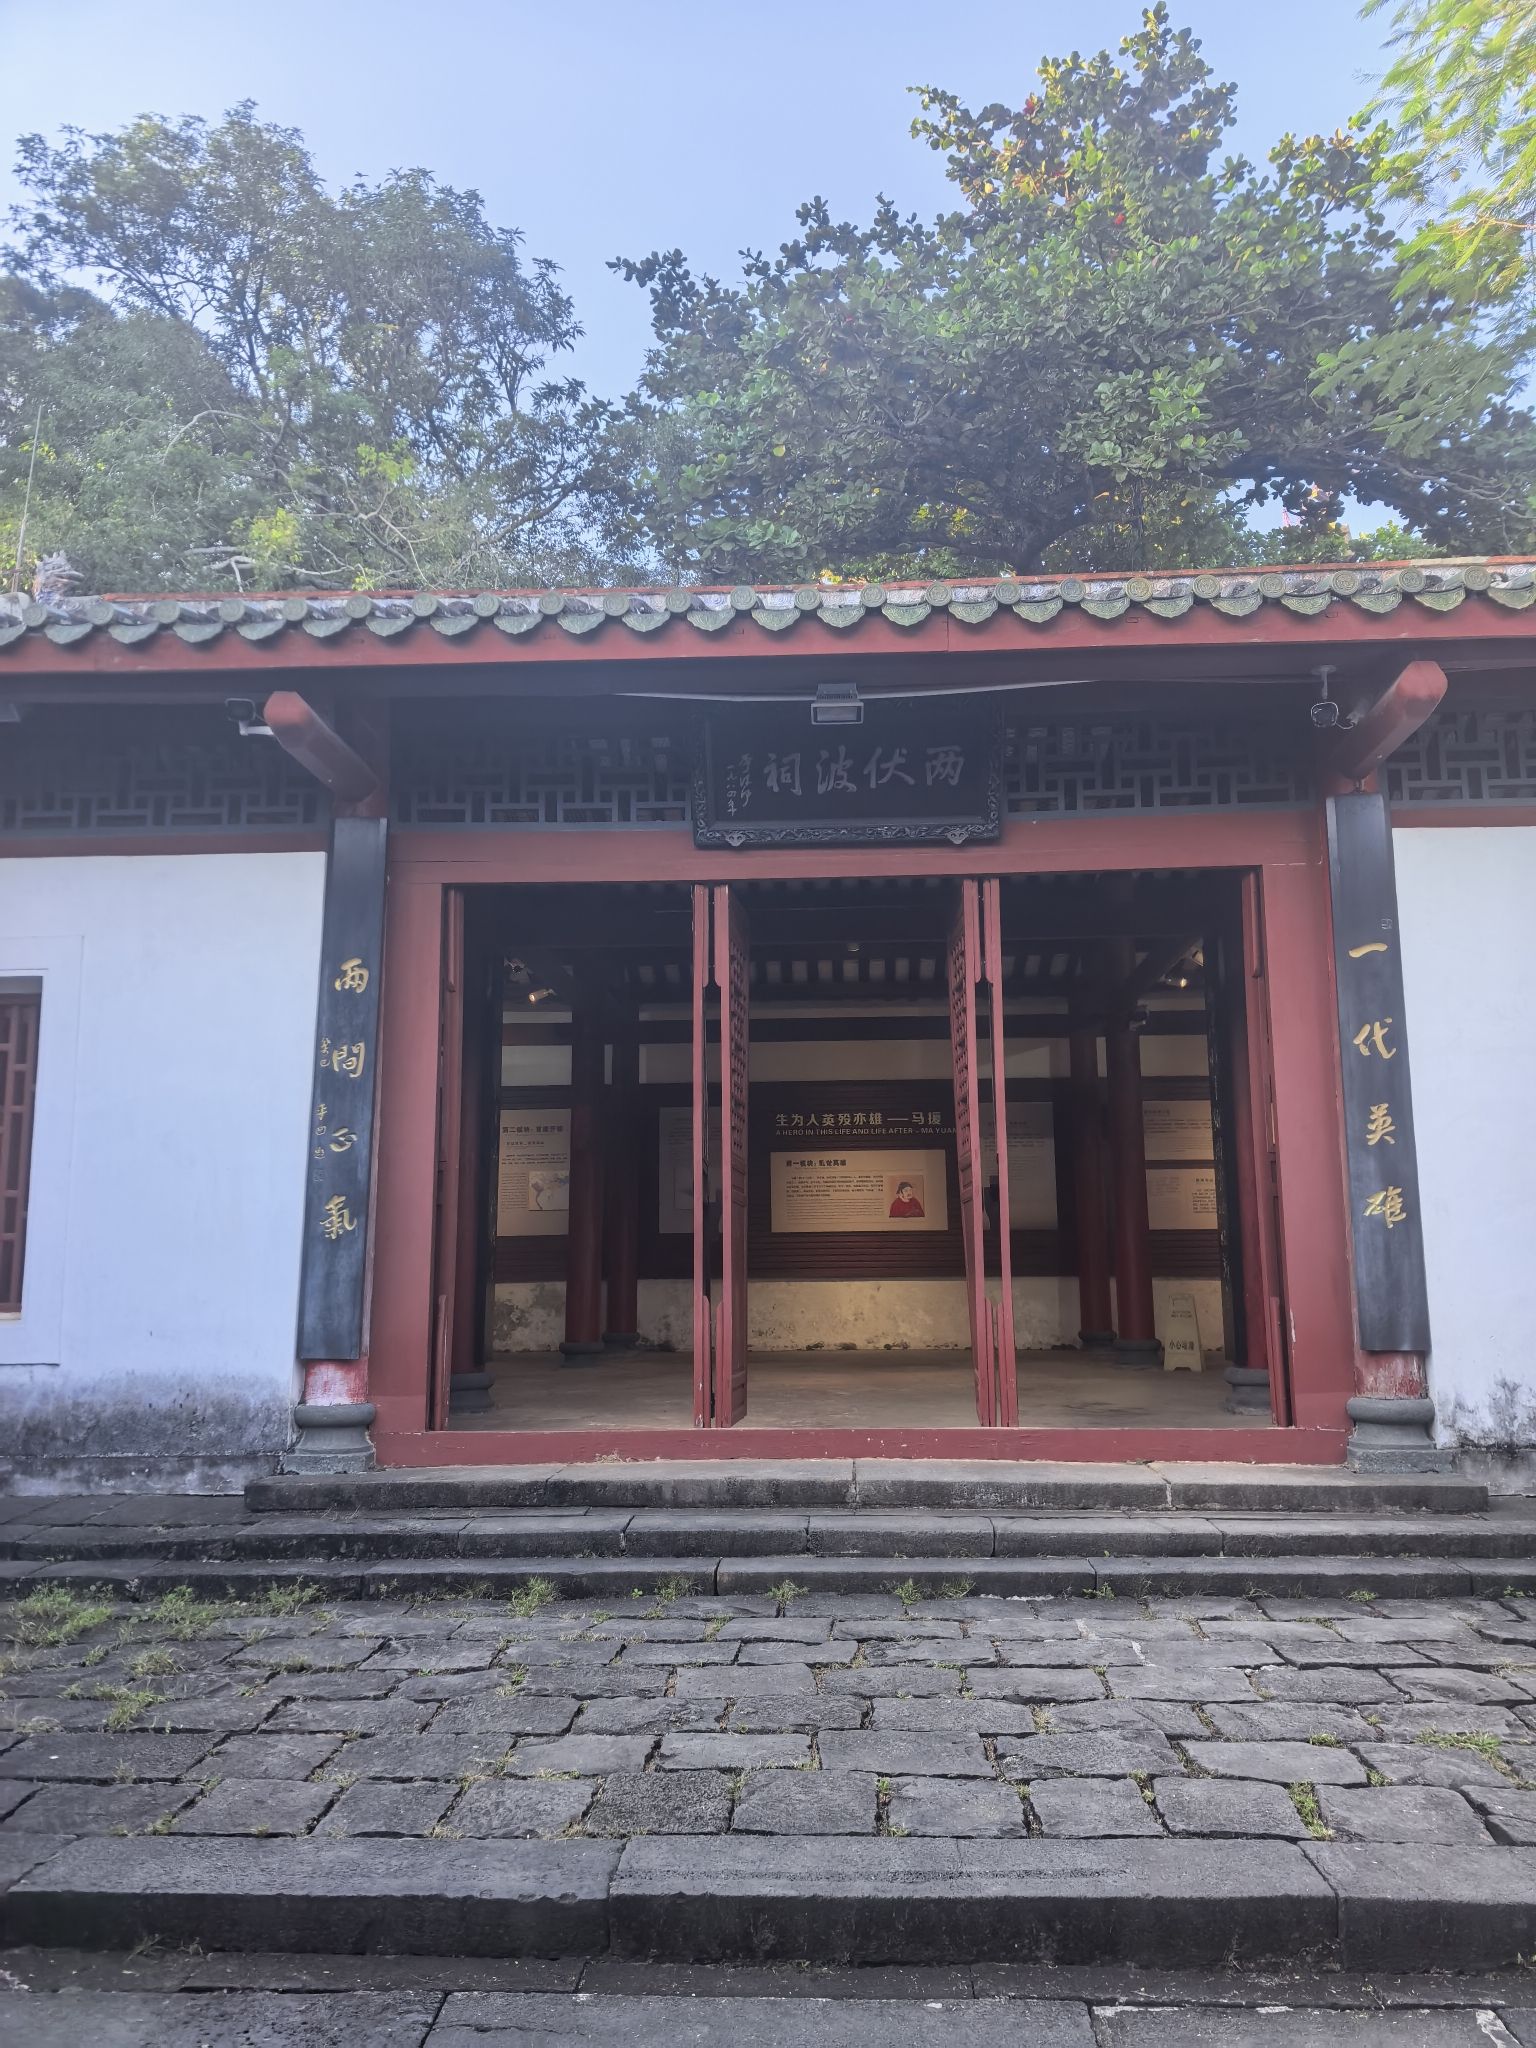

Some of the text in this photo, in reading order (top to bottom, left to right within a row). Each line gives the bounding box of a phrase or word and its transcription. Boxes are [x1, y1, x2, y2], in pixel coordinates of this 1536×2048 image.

[764, 745, 965, 796] 两伏波祠
[1349, 942, 1407, 1229] 一代英雄
